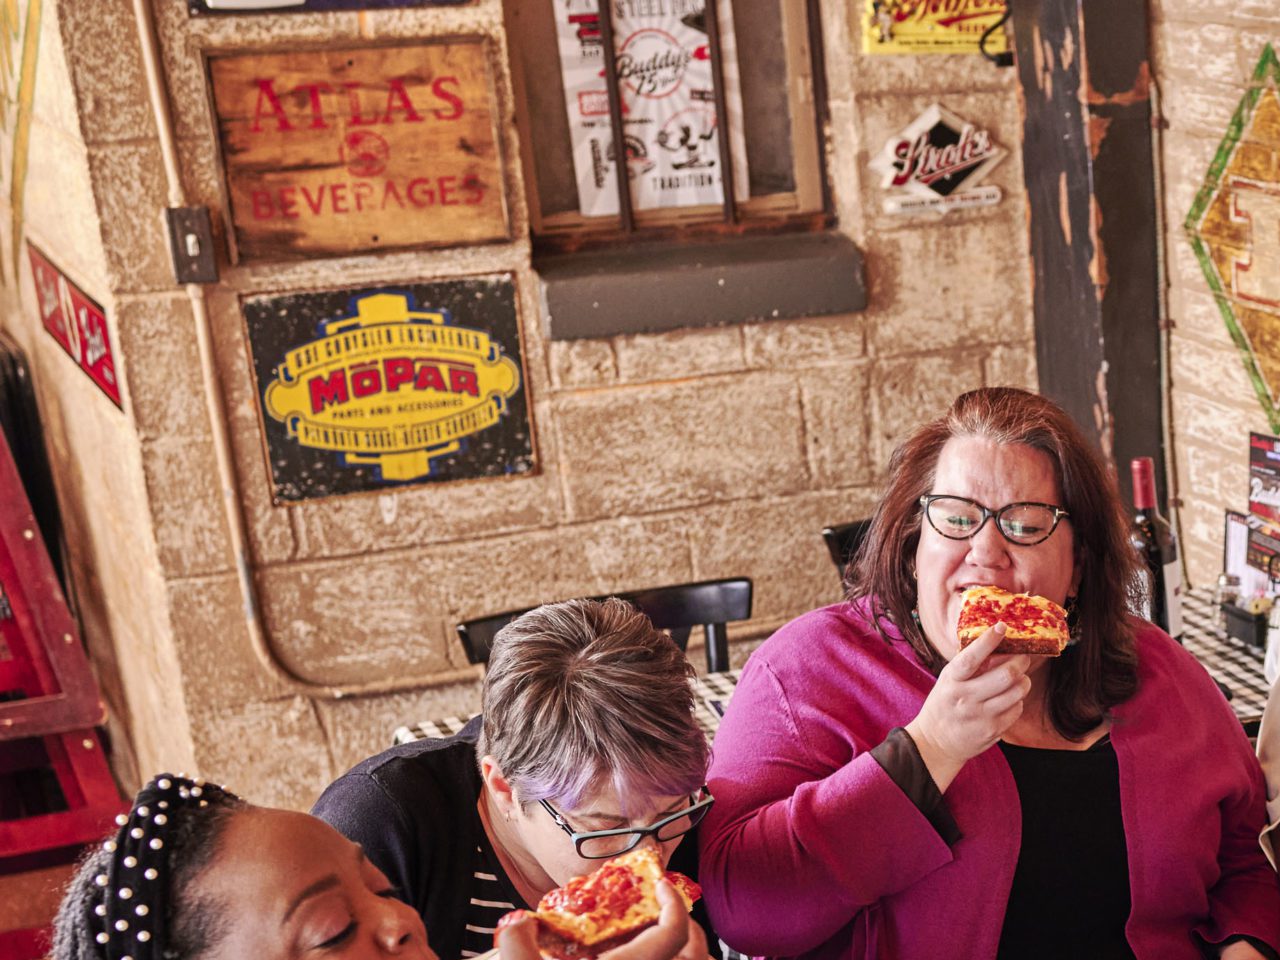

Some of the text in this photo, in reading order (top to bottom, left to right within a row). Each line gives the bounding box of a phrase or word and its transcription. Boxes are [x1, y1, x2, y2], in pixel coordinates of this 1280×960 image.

[617, 50, 691, 79] Buddy's
[250, 75, 466, 133] ATLAS
[892, 123, 993, 186] Stroh's
[251, 173, 485, 221] BEVERAGES
[308, 357, 480, 415] MOPAR
